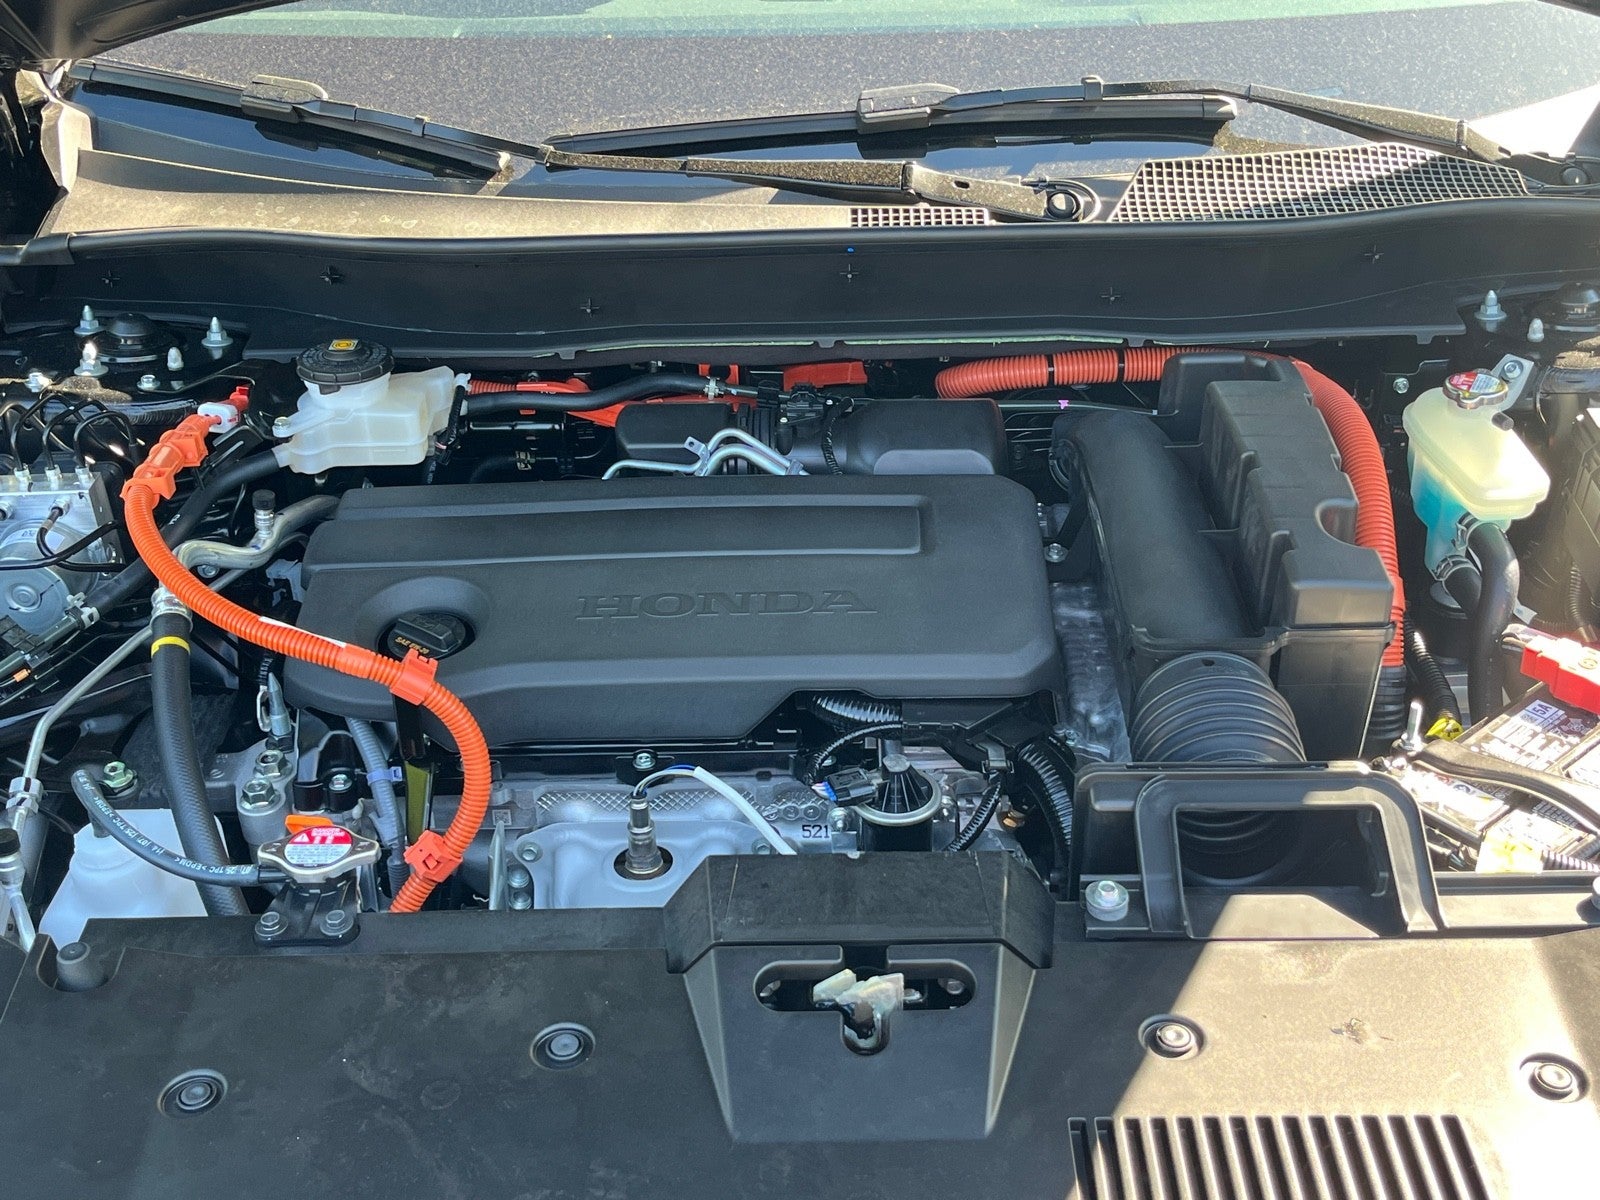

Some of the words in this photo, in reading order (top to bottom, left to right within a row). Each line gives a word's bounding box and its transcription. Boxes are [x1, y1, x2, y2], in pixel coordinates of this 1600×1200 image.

[576, 590, 879, 620] HONDA
[394, 636, 411, 647] SAE
[1532, 703, 1553, 716] 5A
[112, 817, 126, 830] TPC
[801, 824, 830, 839] 521
[208, 866, 224, 874] TPC
